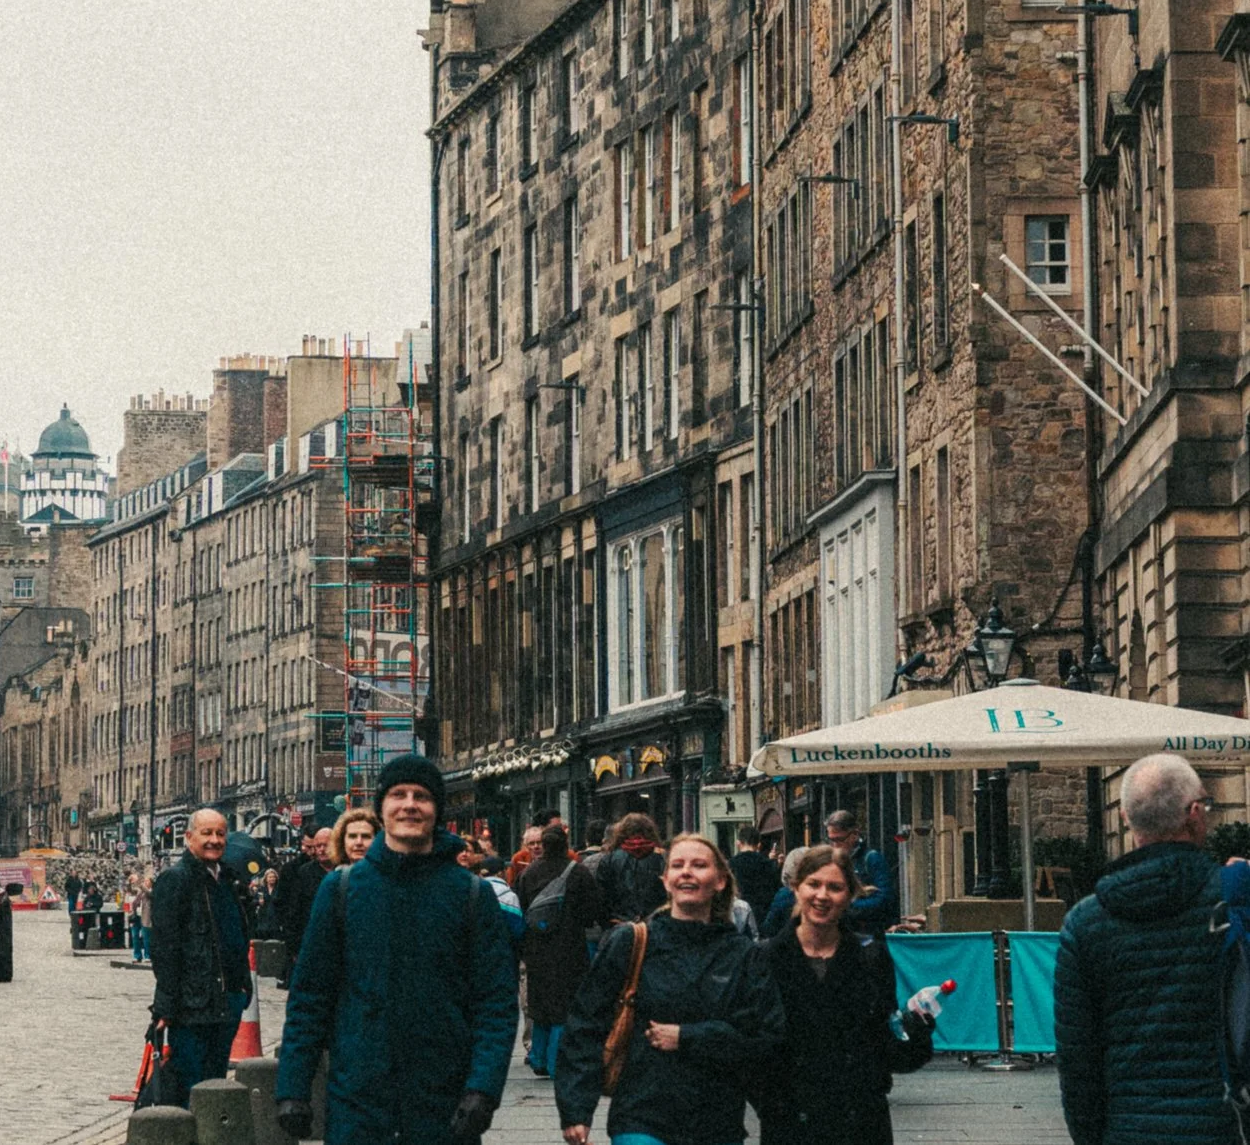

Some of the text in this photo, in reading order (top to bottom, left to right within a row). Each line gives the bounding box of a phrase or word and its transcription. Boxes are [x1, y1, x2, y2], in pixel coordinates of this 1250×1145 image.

[790, 743, 951, 764] Luckenbooths
[1162, 736, 1187, 751] All
[1193, 736, 1228, 753] Day
